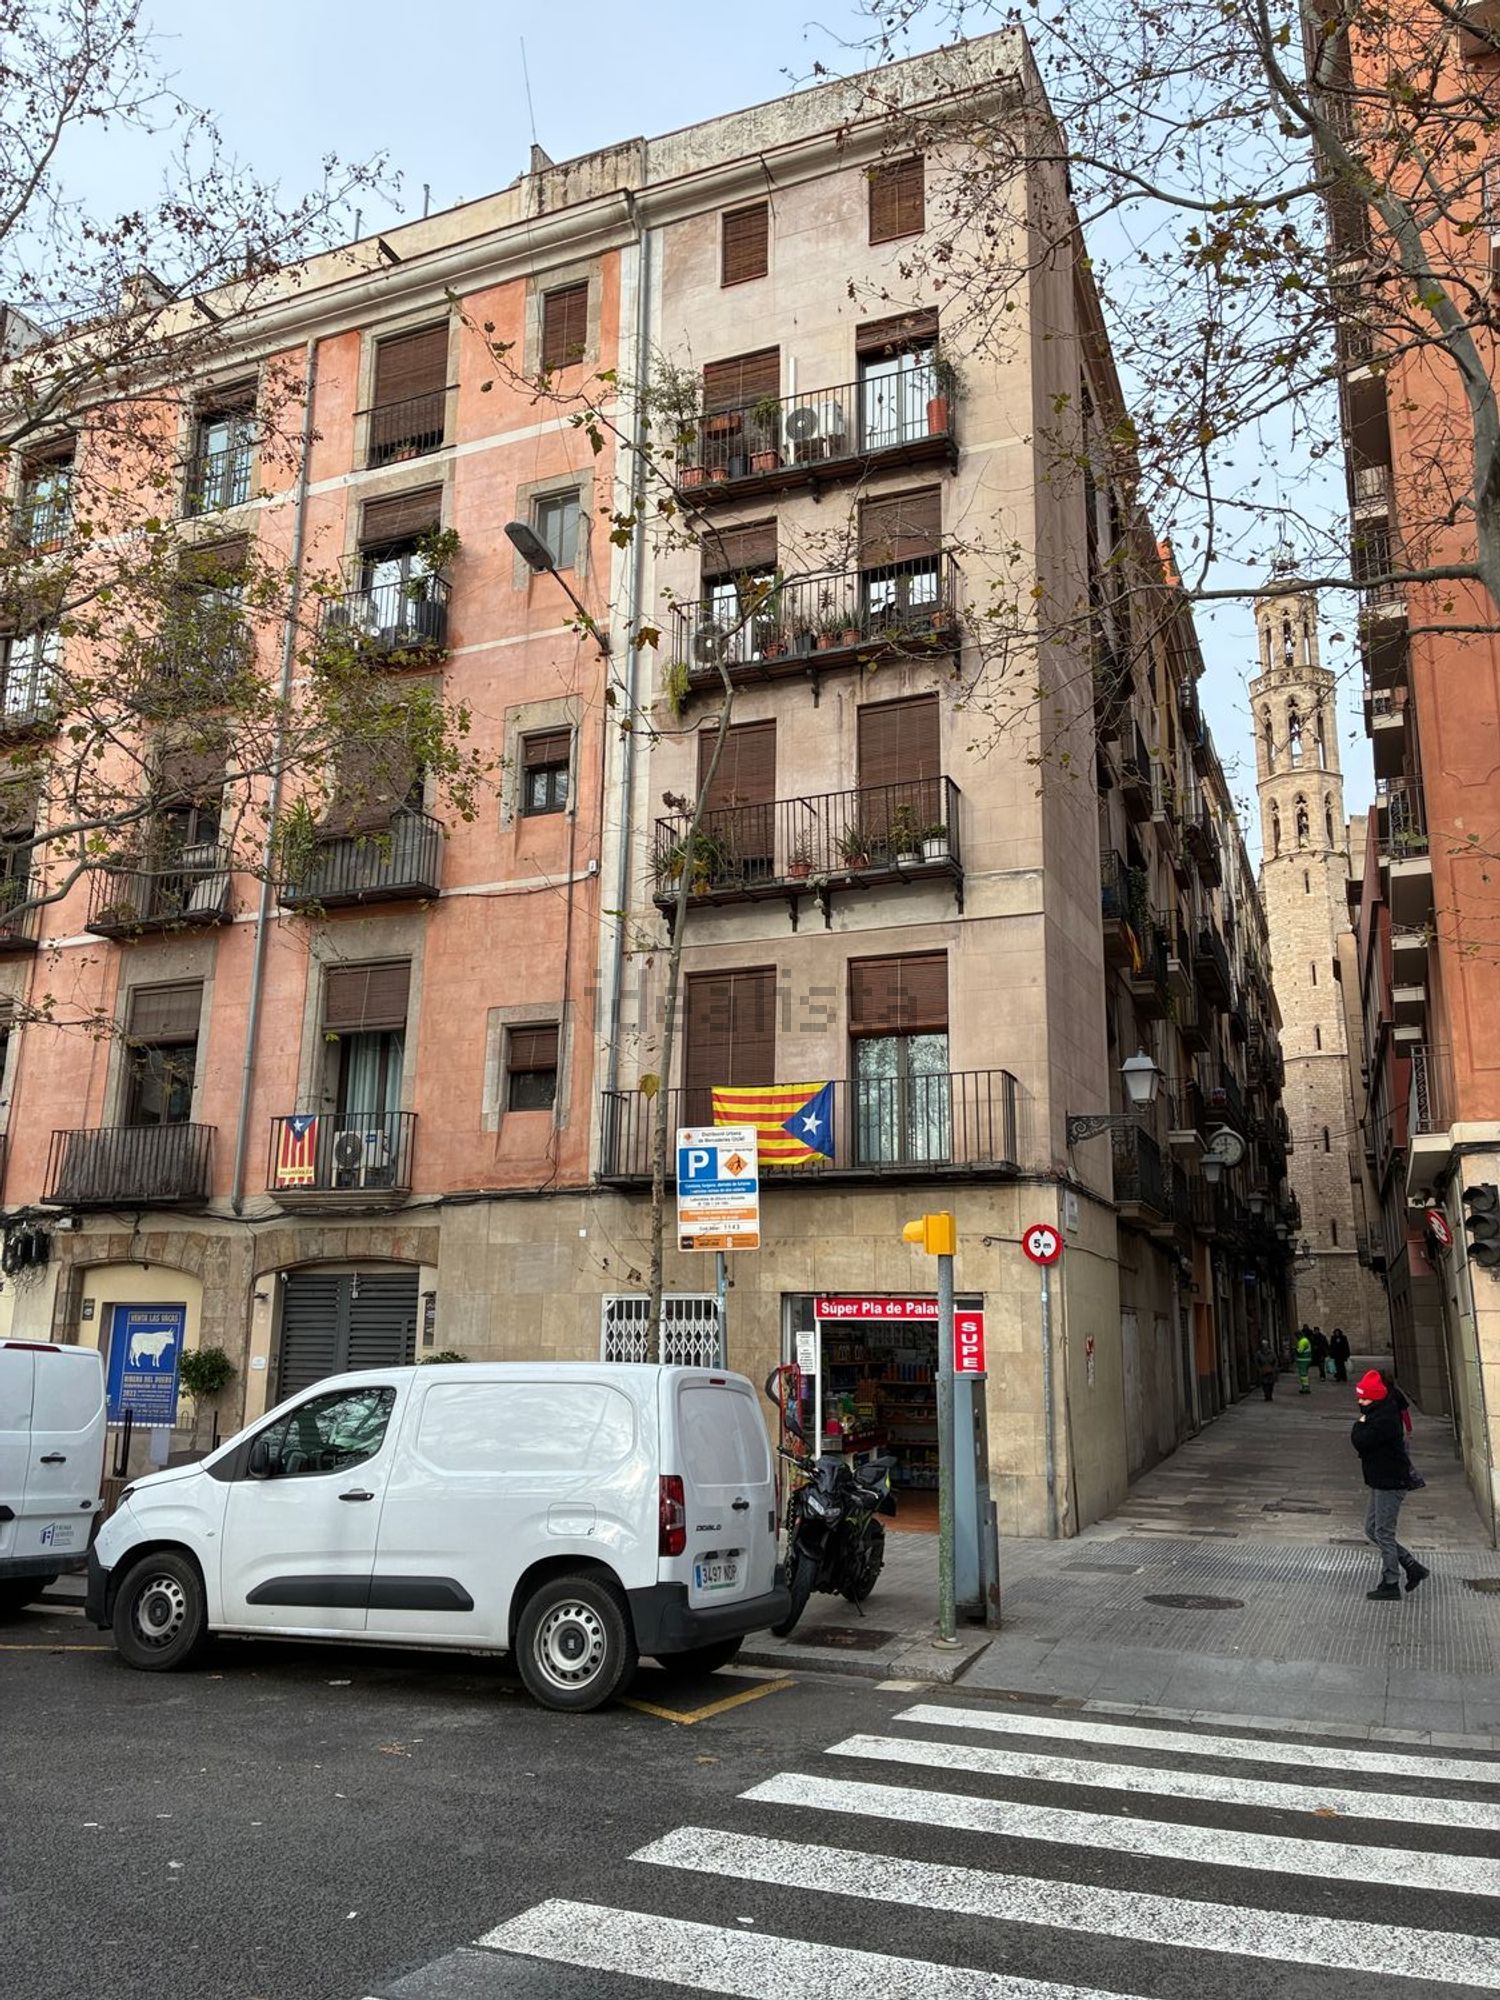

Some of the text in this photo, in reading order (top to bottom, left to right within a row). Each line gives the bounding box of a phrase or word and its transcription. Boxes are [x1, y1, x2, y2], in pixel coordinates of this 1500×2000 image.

[688, 1150, 709, 1178] P
[1033, 1239, 1041, 1249] 5
[821, 1301, 858, 1316] Súper
[862, 1302, 882, 1315] Pla
[886, 1302, 902, 1314] de
[961, 1321, 978, 1372] SUPE
[703, 1565, 722, 1583] 3497
